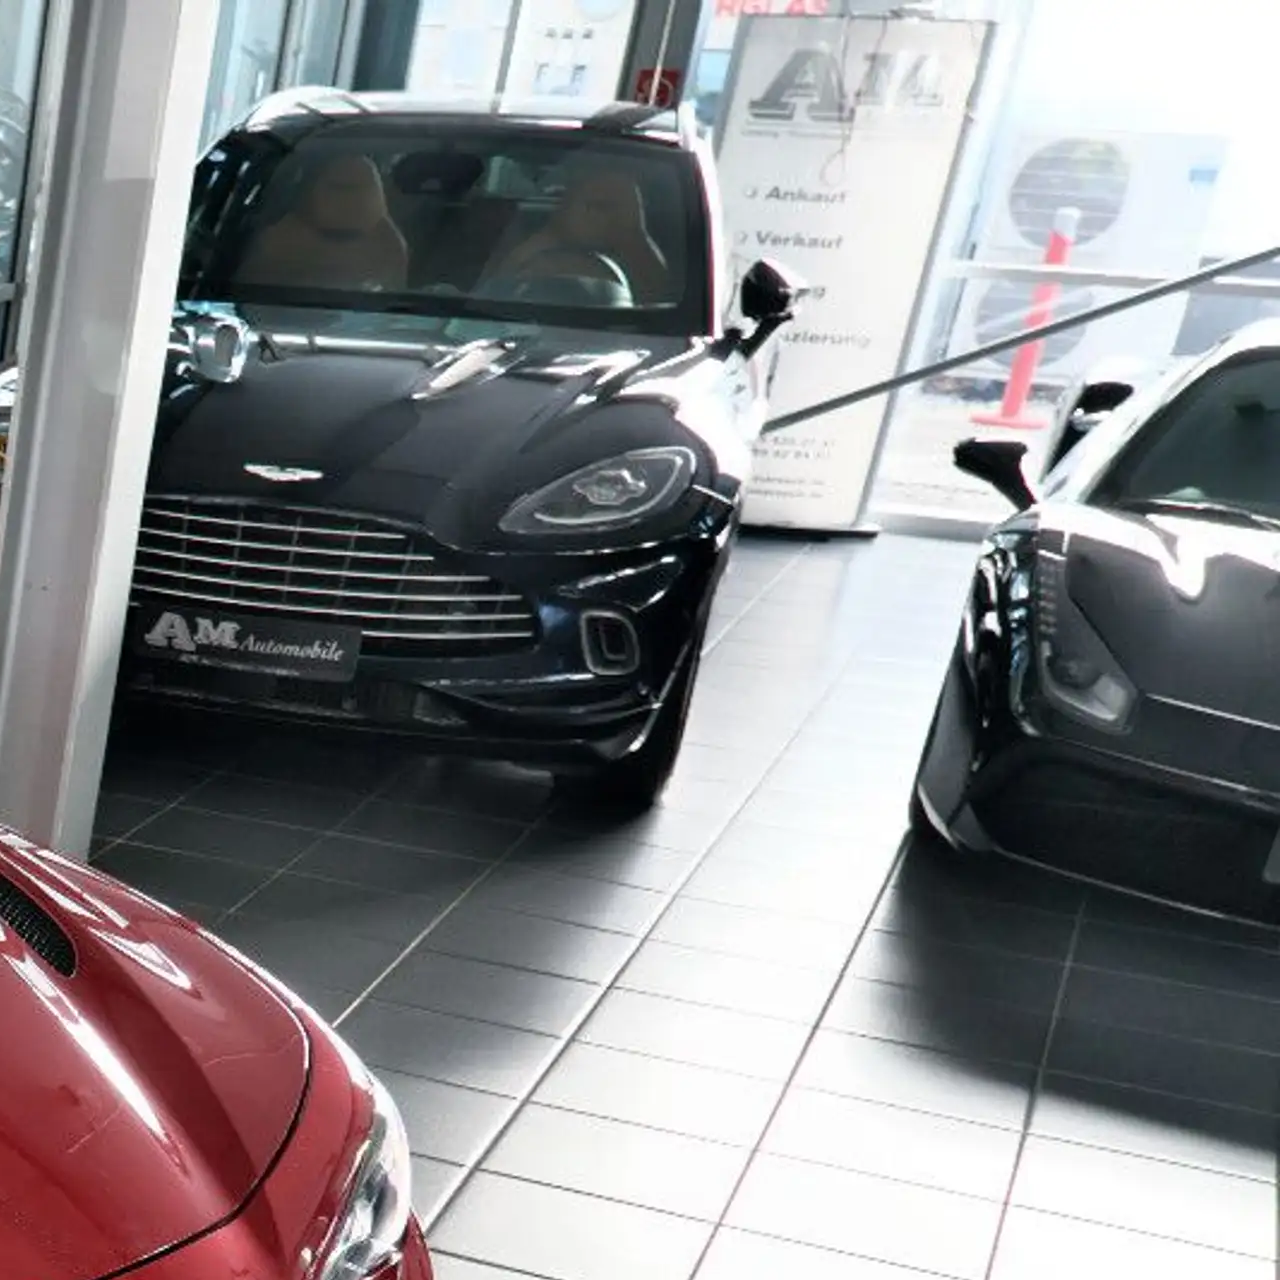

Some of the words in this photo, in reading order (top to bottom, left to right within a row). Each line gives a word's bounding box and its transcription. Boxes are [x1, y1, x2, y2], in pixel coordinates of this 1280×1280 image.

[746, 46, 945, 123] AM
[765, 185, 847, 203] Ankauf
[755, 230, 844, 249] Verkauf
[144, 611, 241, 651] AM
[241, 633, 344, 662] Automobile
